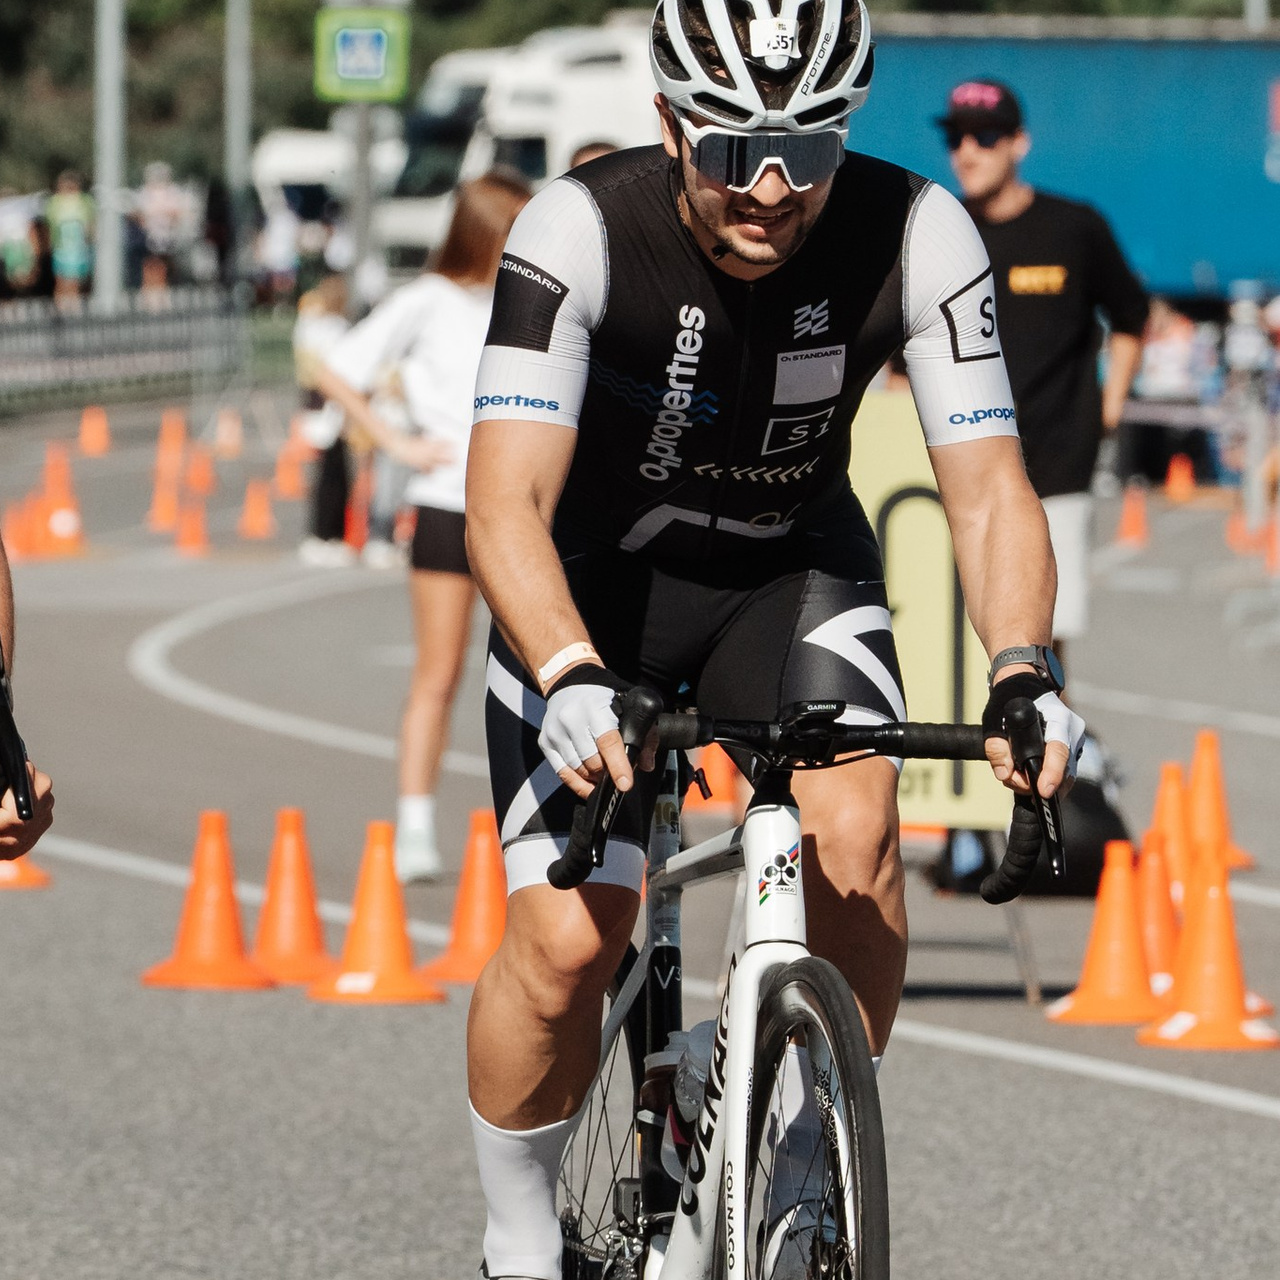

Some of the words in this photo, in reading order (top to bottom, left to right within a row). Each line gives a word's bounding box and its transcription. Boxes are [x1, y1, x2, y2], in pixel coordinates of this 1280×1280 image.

[503, 258, 562, 295] STANDARD
[793, 349, 842, 361] STANDARD
[806, 703, 837, 711] GARMIN
[681, 952, 736, 1217] COLNA
[725, 1160, 736, 1270] COLNAGO
